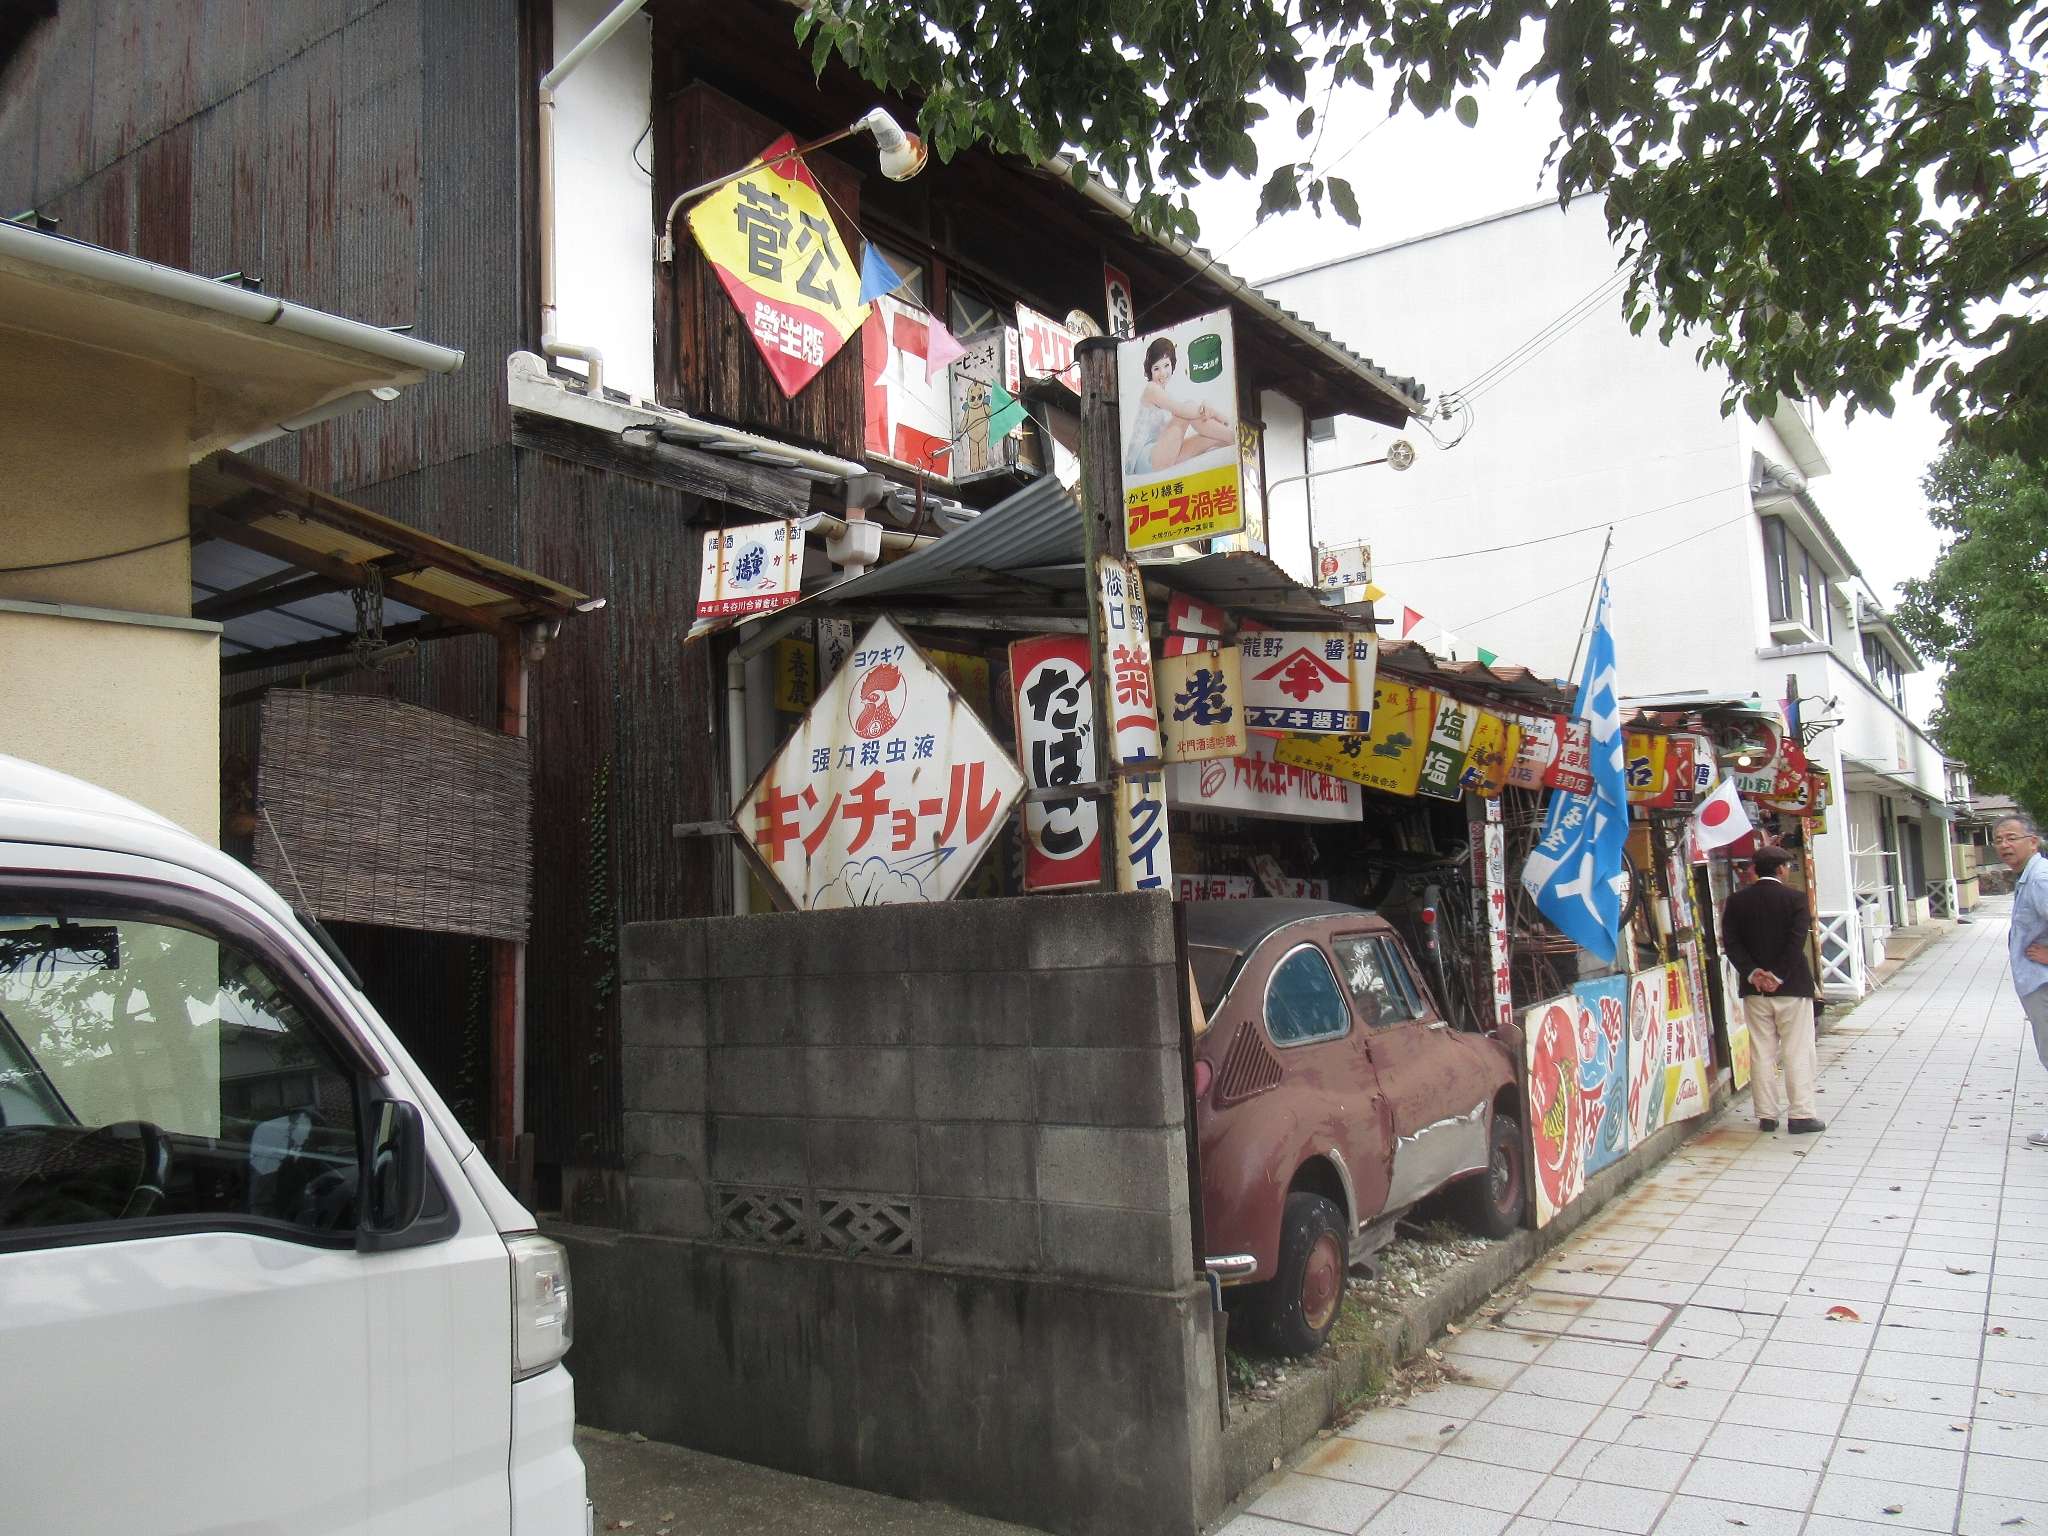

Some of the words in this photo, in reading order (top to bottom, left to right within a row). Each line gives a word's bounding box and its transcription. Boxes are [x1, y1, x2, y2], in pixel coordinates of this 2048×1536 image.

[733, 181, 841, 311] 菅公
[1128, 488, 1237, 535] アース渦巻
[1129, 482, 1185, 504] かとり線香
[1105, 567, 1126, 630] 淡口
[854, 645, 905, 667] ヨクキク
[1242, 637, 1284, 658] 龍野
[1113, 643, 1157, 734] 菊一
[1026, 668, 1091, 855] たばこ
[755, 760, 1002, 864] キンチョール
